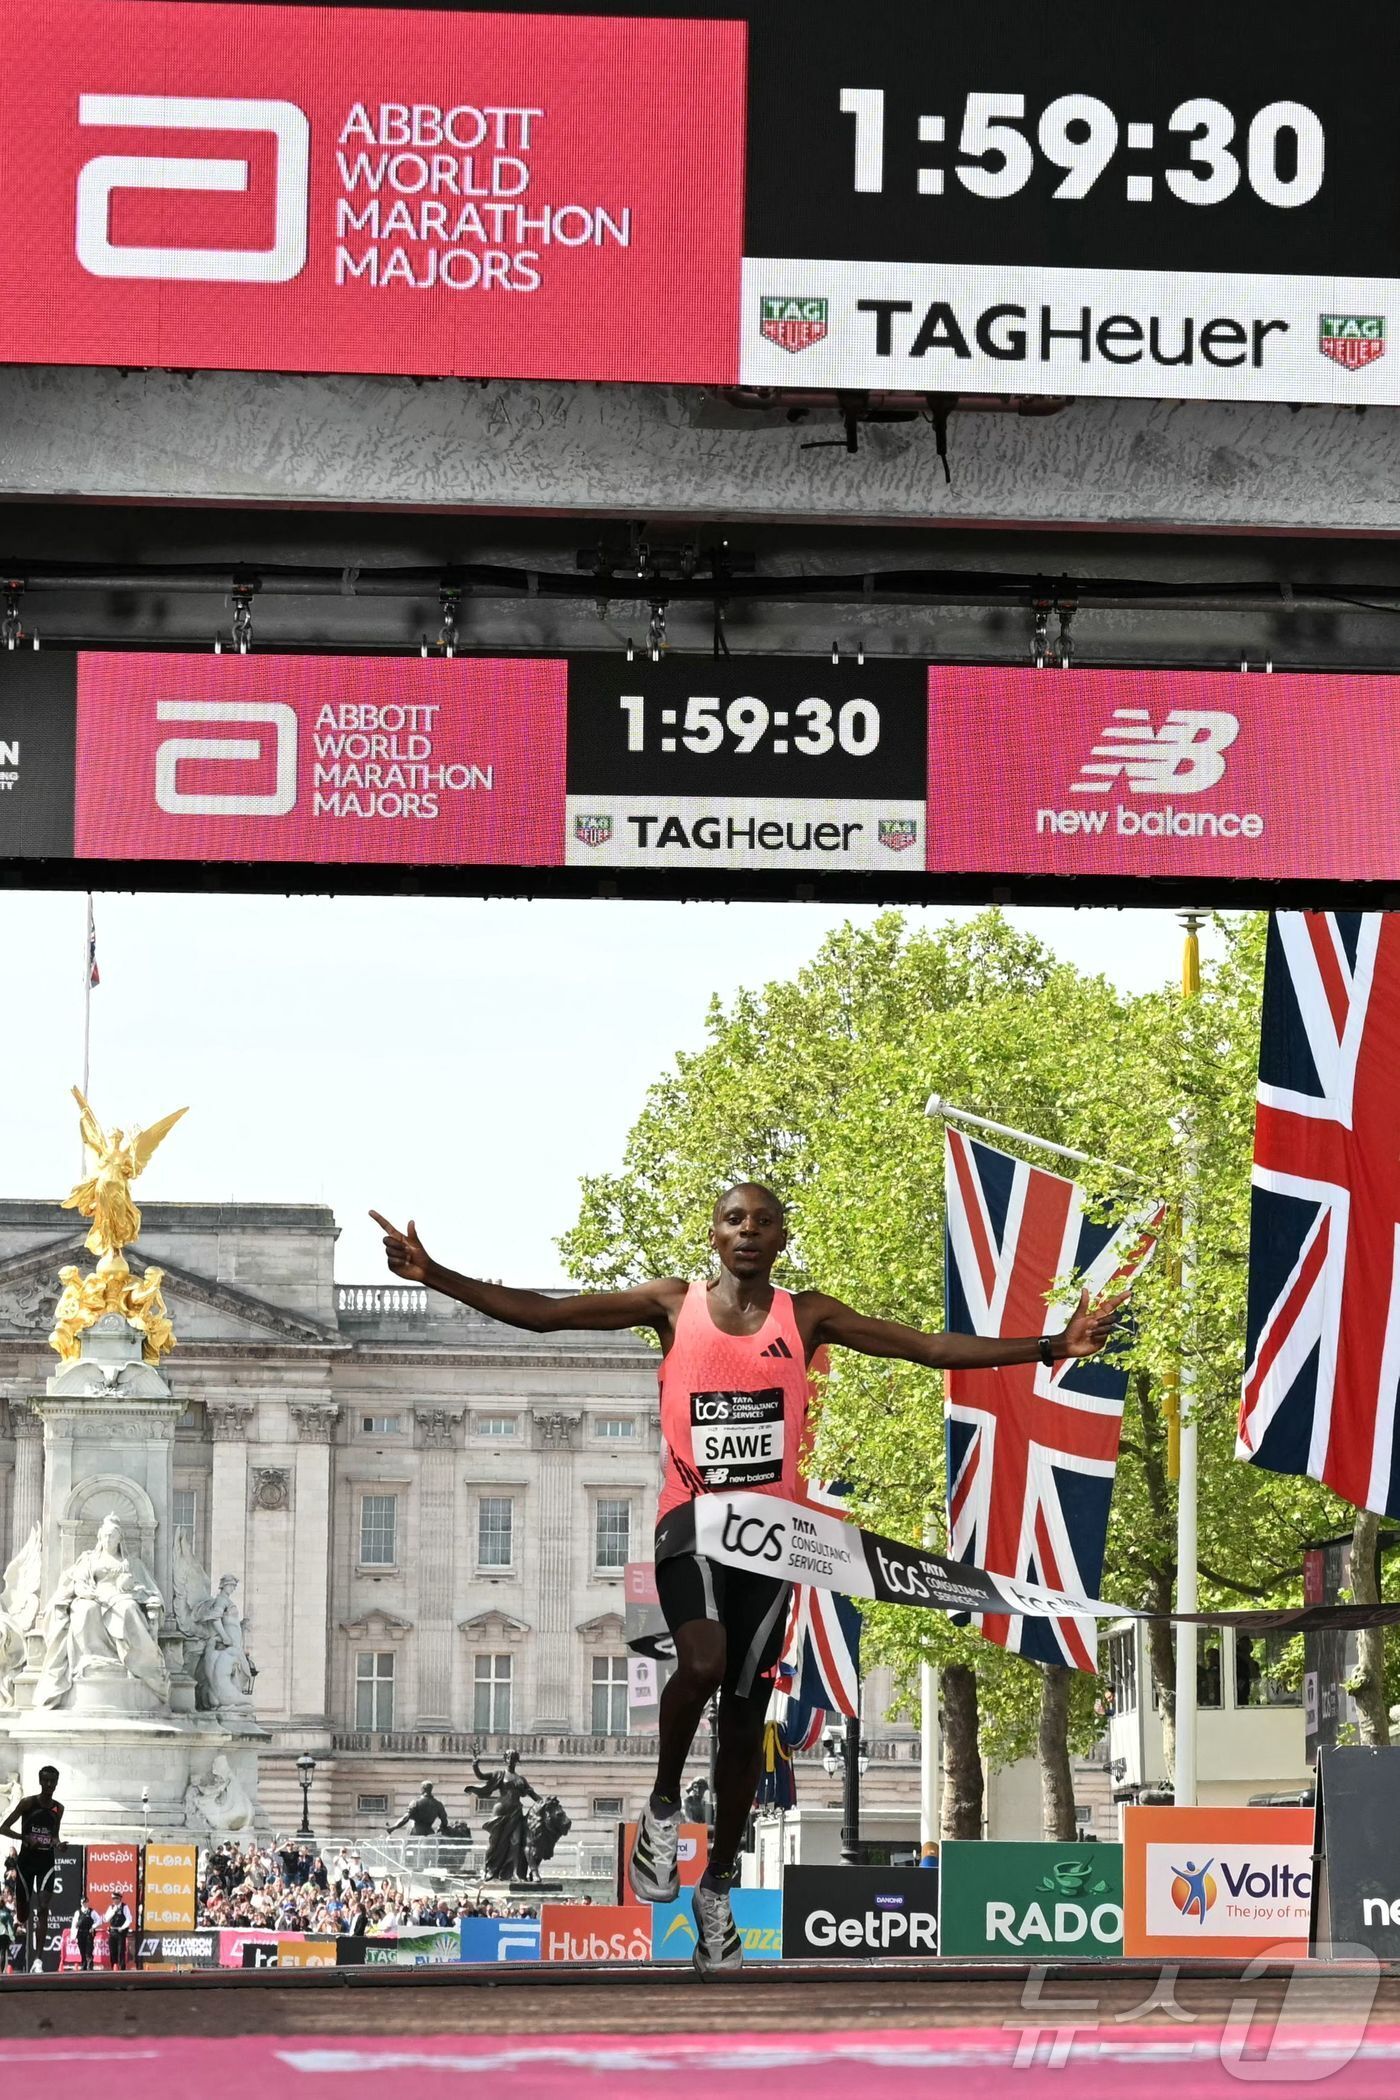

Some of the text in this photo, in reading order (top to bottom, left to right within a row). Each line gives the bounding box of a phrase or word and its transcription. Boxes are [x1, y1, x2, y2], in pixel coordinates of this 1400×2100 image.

[338, 103, 545, 150] ABBOTT
[839, 87, 1325, 209] 1:59:30
[336, 151, 530, 197] WORLD
[336, 199, 632, 247] MARATHON
[336, 246, 541, 292] MAJORS
[769, 302, 820, 319] TAG
[763, 322, 825, 348] HEUER
[1326, 319, 1379, 338] TAG
[1323, 341, 1384, 366] HEUER
[315, 704, 440, 730] ABBOTT
[619, 696, 880, 756] 1:59:30
[313, 733, 431, 760] WORLD
[313, 763, 494, 791] MARATHON
[313, 792, 439, 819] MAJORS
[1036, 804, 1264, 838] new balance
[695, 1397, 729, 1420] tcs
[732, 1402, 778, 1411] CONSULTANCY
[732, 1410, 764, 1419] SERVICES
[705, 1434, 772, 1460] SAWE
[747, 1472, 774, 1482] balance
[722, 1503, 785, 1561] tcs
[792, 1517, 817, 1536] TATA
[791, 1535, 851, 1563] CONSULTANCY
[787, 1553, 833, 1575] SERVICES
[876, 1547, 930, 1598] tcs
[918, 1560, 947, 1578] TATA
[925, 1577, 989, 1599] CONSULTANCY
[933, 1591, 979, 1606] SERVICES
[90, 1850, 133, 1863] HubSpot
[148, 1855, 192, 1866] FLORA
[90, 1881, 133, 1893] HubSpot
[147, 1883, 191, 1894] FLORA
[147, 1911, 191, 1922] FLORA
[985, 1902, 1123, 1946] RADO
[1226, 1905, 1250, 1917] The
[1253, 1906, 1273, 1920] joy
[1277, 1905, 1291, 1918] of
[804, 1910, 938, 1949] GetPR
[162, 1947, 212, 1957] MARATHON
